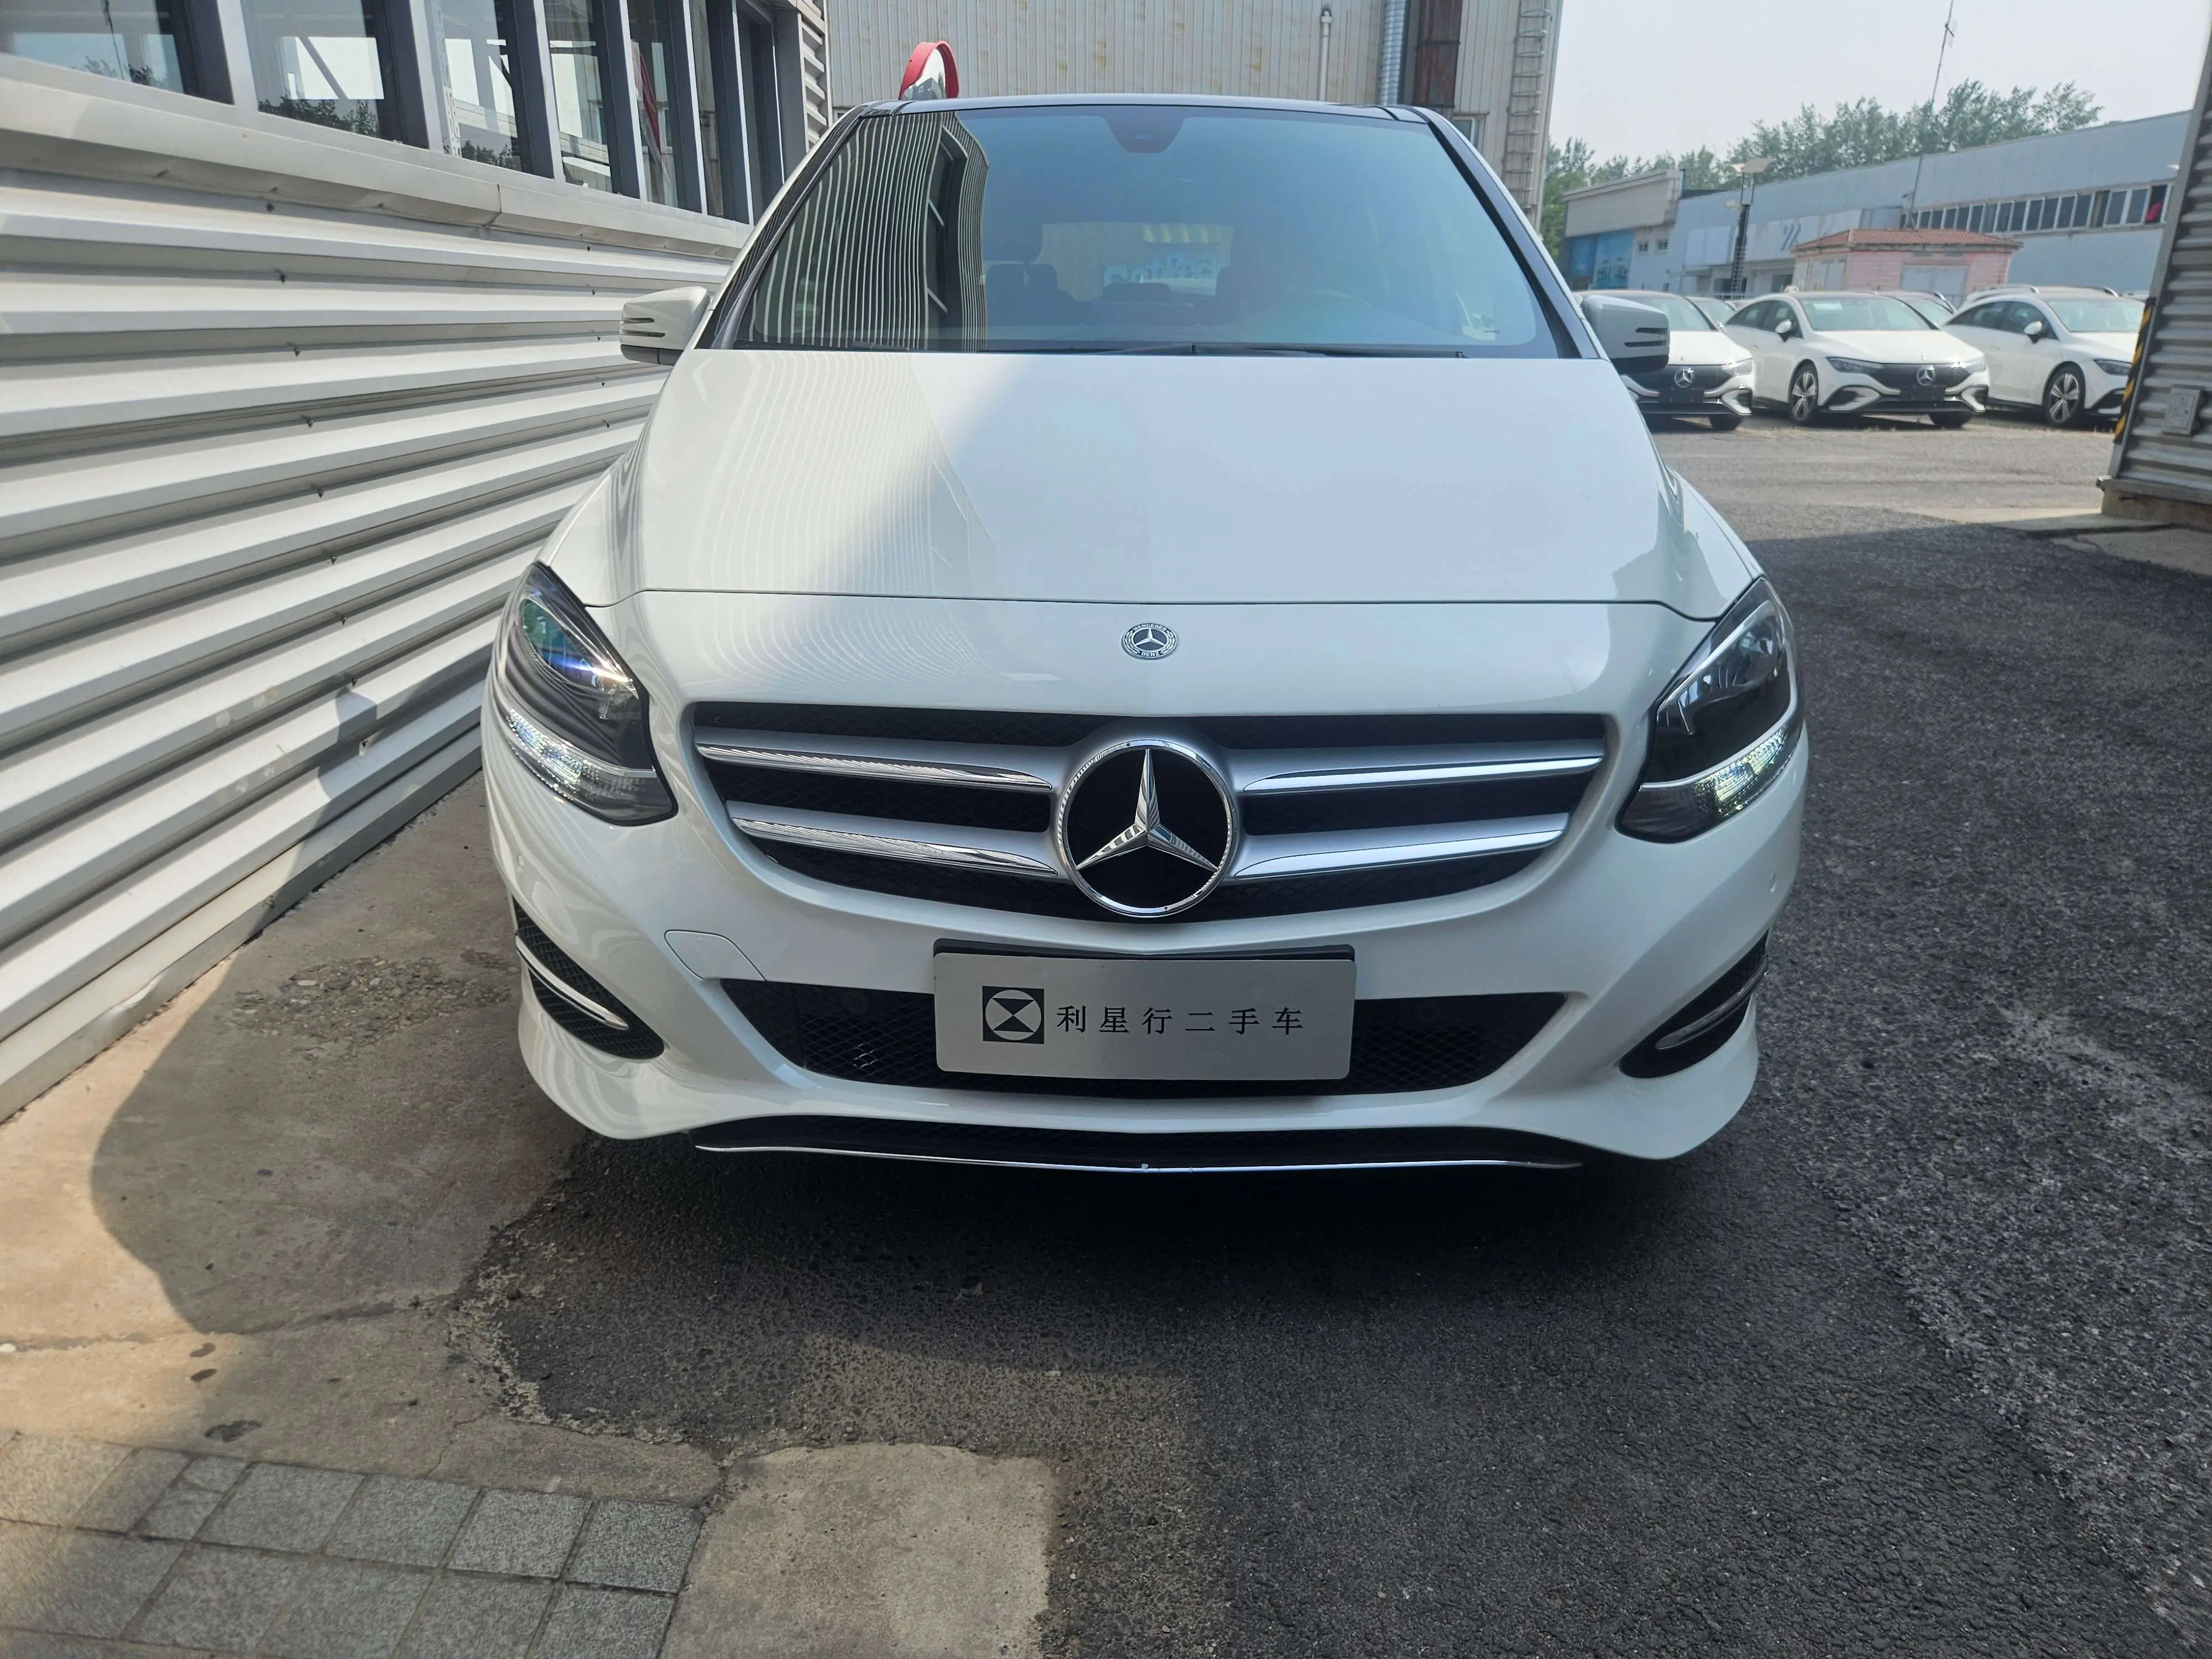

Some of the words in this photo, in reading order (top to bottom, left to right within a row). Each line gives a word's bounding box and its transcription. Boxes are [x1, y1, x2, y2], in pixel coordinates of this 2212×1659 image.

[1132, 623, 1167, 632] MERCEDES
[1056, 1005, 1303, 1035] 利星行二手车
